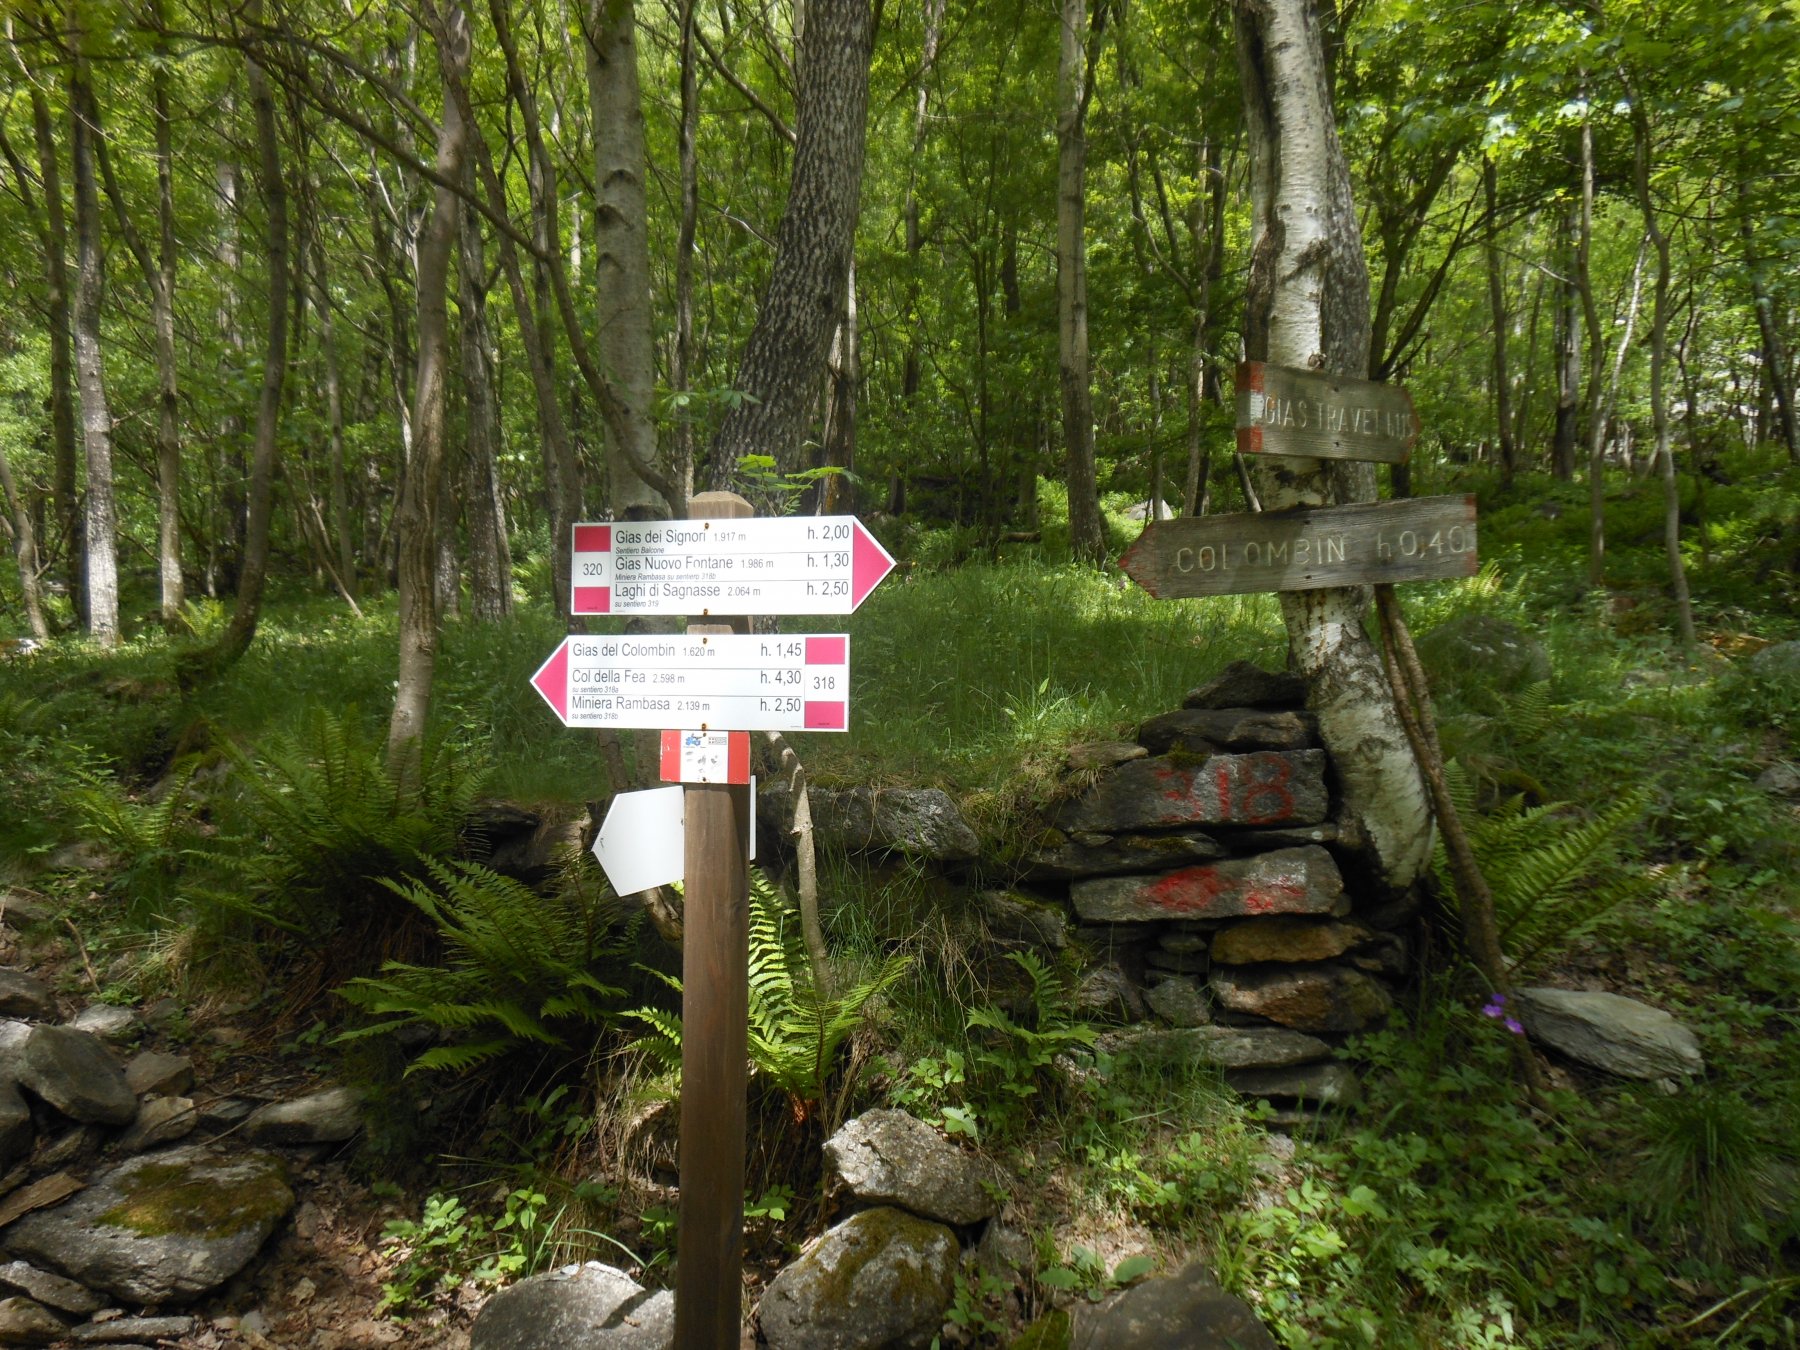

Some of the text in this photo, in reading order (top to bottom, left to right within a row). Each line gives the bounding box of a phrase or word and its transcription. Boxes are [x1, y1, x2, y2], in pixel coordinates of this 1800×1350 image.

[1264, 396, 1307, 428] GIAS
[615, 530, 642, 544] Gias
[645, 529, 662, 543] dei
[665, 529, 706, 546] Signori
[713, 532, 735, 542] 1.917
[807, 525, 849, 541] h. 2,00
[615, 546, 665, 555] Sentiero Balcone
[1176, 534, 1346, 574] COLOMBIN
[583, 562, 603, 576] 320
[615, 555, 774, 570] Gias Nuovo Fontane 1.986 m
[807, 553, 849, 569] h. 1,30
[637, 572, 666, 581] Rambasa
[615, 583, 761, 600] Laghi di Sagnasse 2.064 m
[806, 581, 849, 597] h. 2,50
[573, 643, 716, 657] Gias del Colombin 1.620 m
[761, 643, 802, 659] h. 1,45
[572, 669, 591, 683] Col
[594, 669, 621, 683] della
[624, 669, 646, 683] Fea
[653, 674, 675, 683] 2.598
[760, 670, 801, 686] h. 4,30
[813, 676, 835, 690] 318
[572, 696, 710, 711] Miniera Rambasa 2.139 m
[760, 698, 801, 714] h. 2,50
[1155, 754, 1295, 825] 318
